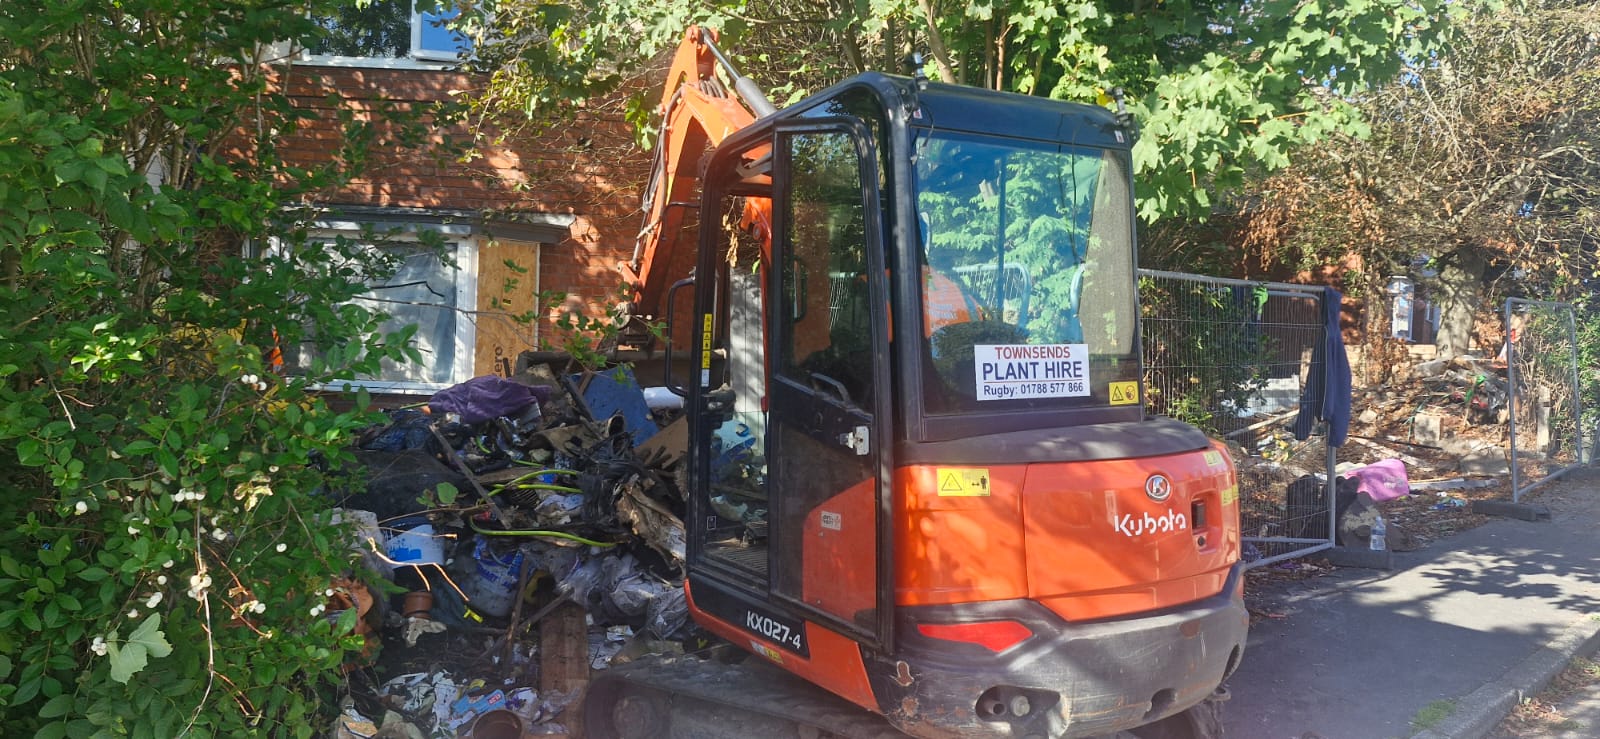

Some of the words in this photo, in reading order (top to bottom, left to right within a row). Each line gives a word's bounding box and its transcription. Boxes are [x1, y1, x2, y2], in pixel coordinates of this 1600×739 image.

[495, 346, 503, 376] ero
[995, 346, 1070, 359] TOWNSENDS
[982, 362, 1039, 380] PLANT
[1045, 361, 1083, 379] HIRE
[983, 384, 1018, 397] Rugby:
[1020, 383, 1047, 395] 01788
[1050, 383, 1065, 393] 577
[1067, 382, 1083, 393] 866
[1114, 508, 1187, 537] Kubota
[746, 610, 801, 649] KX027-4
